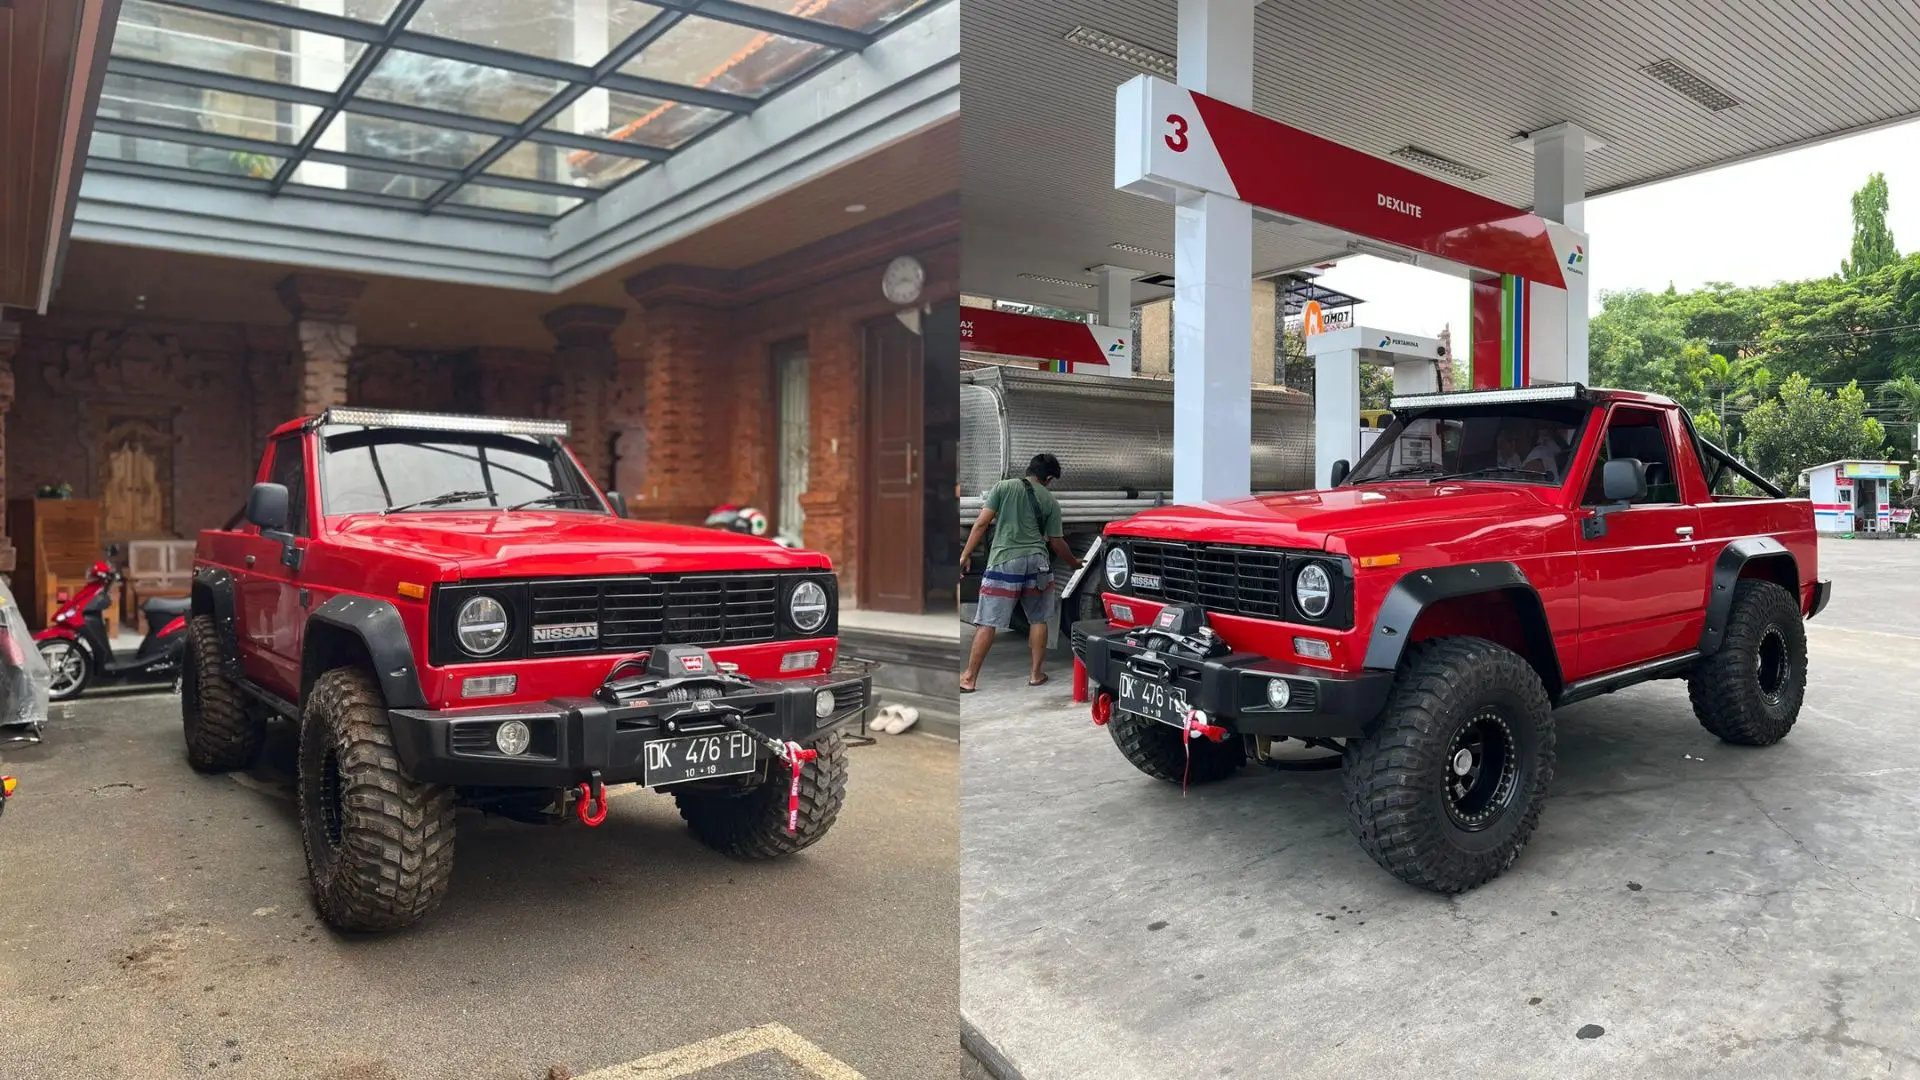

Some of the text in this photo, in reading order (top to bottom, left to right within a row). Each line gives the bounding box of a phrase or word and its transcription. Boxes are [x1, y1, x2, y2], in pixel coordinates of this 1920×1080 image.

[1164, 114, 1188, 152] 3
[1377, 192, 1422, 219] DEXLITE
[1321, 311, 1350, 325] OMOT
[961, 329, 973, 338] 92
[1131, 575, 1159, 587] NISSAN
[533, 626, 598, 640] NISSAN
[1121, 675, 1135, 700] DK
[1142, 682, 1164, 707] 476
[649, 733, 752, 770] DK 476 FD
[685, 764, 717, 777] 10 19
